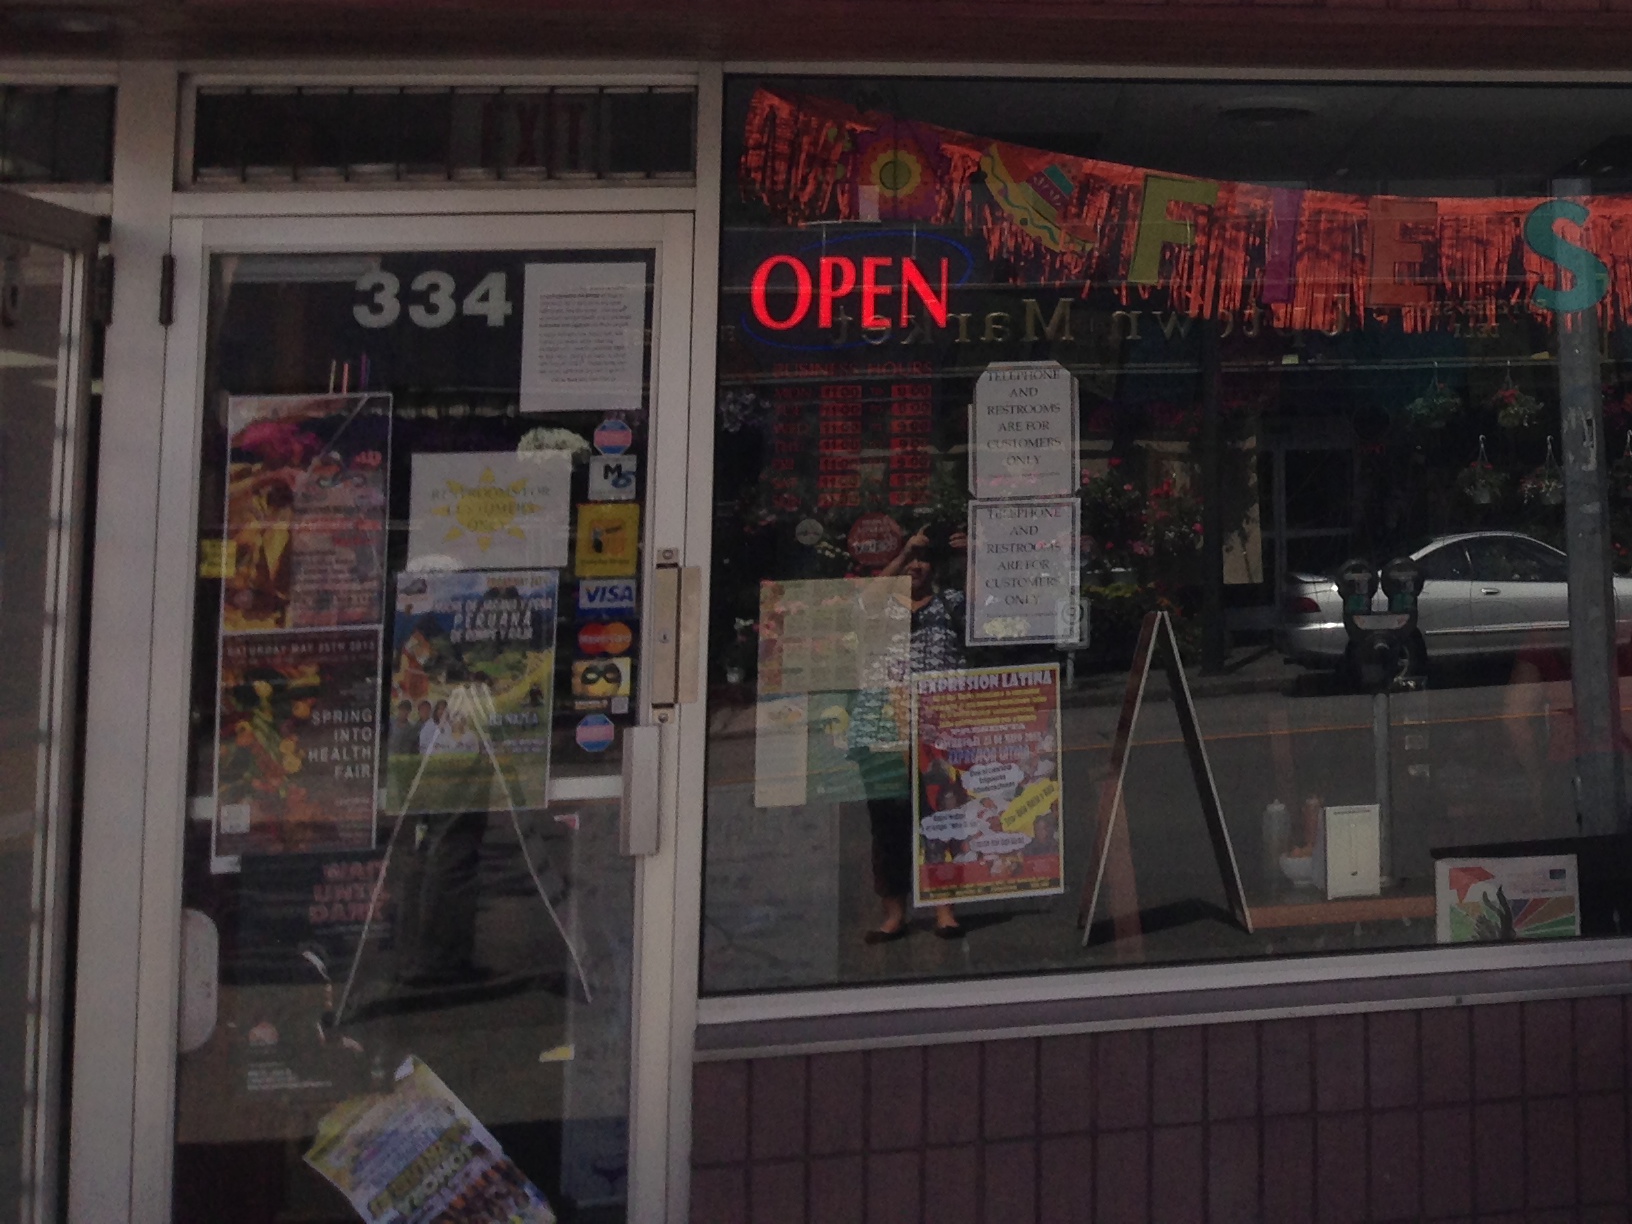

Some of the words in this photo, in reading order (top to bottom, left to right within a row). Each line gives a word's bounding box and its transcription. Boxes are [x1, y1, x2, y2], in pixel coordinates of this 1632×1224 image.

[750, 253, 949, 329] OPEN
[353, 270, 513, 328] 334
[772, 362, 858, 378] BUSINESS
[867, 360, 933, 377] HOURS
[988, 369, 1060, 382] TELEPHONE
[1008, 387, 1039, 398] AND
[987, 403, 1061, 416] RESTROOMS
[998, 421, 1022, 433] ARE
[1026, 420, 1050, 431] FOR
[987, 436, 1062, 449] CUSTOMERS
[1006, 454, 1041, 466] ONLY
[1009, 525, 1039, 536] AND
[997, 559, 1022, 571] ARE
[1025, 559, 1050, 570] FOR
[985, 576, 1061, 589] CUSTOMERS
[585, 584, 634, 604] VISA
[1005, 594, 1040, 606] ONLY
[227, 645, 287, 657] SATURDAY
[291, 643, 314, 654] MAY
[918, 674, 999, 695] EXPRESION
[1002, 669, 1053, 688] LATINA
[311, 707, 373, 726] SPRING
[333, 726, 373, 742] INTO
[308, 745, 372, 763] HEALTH
[334, 763, 371, 780] FAIR
